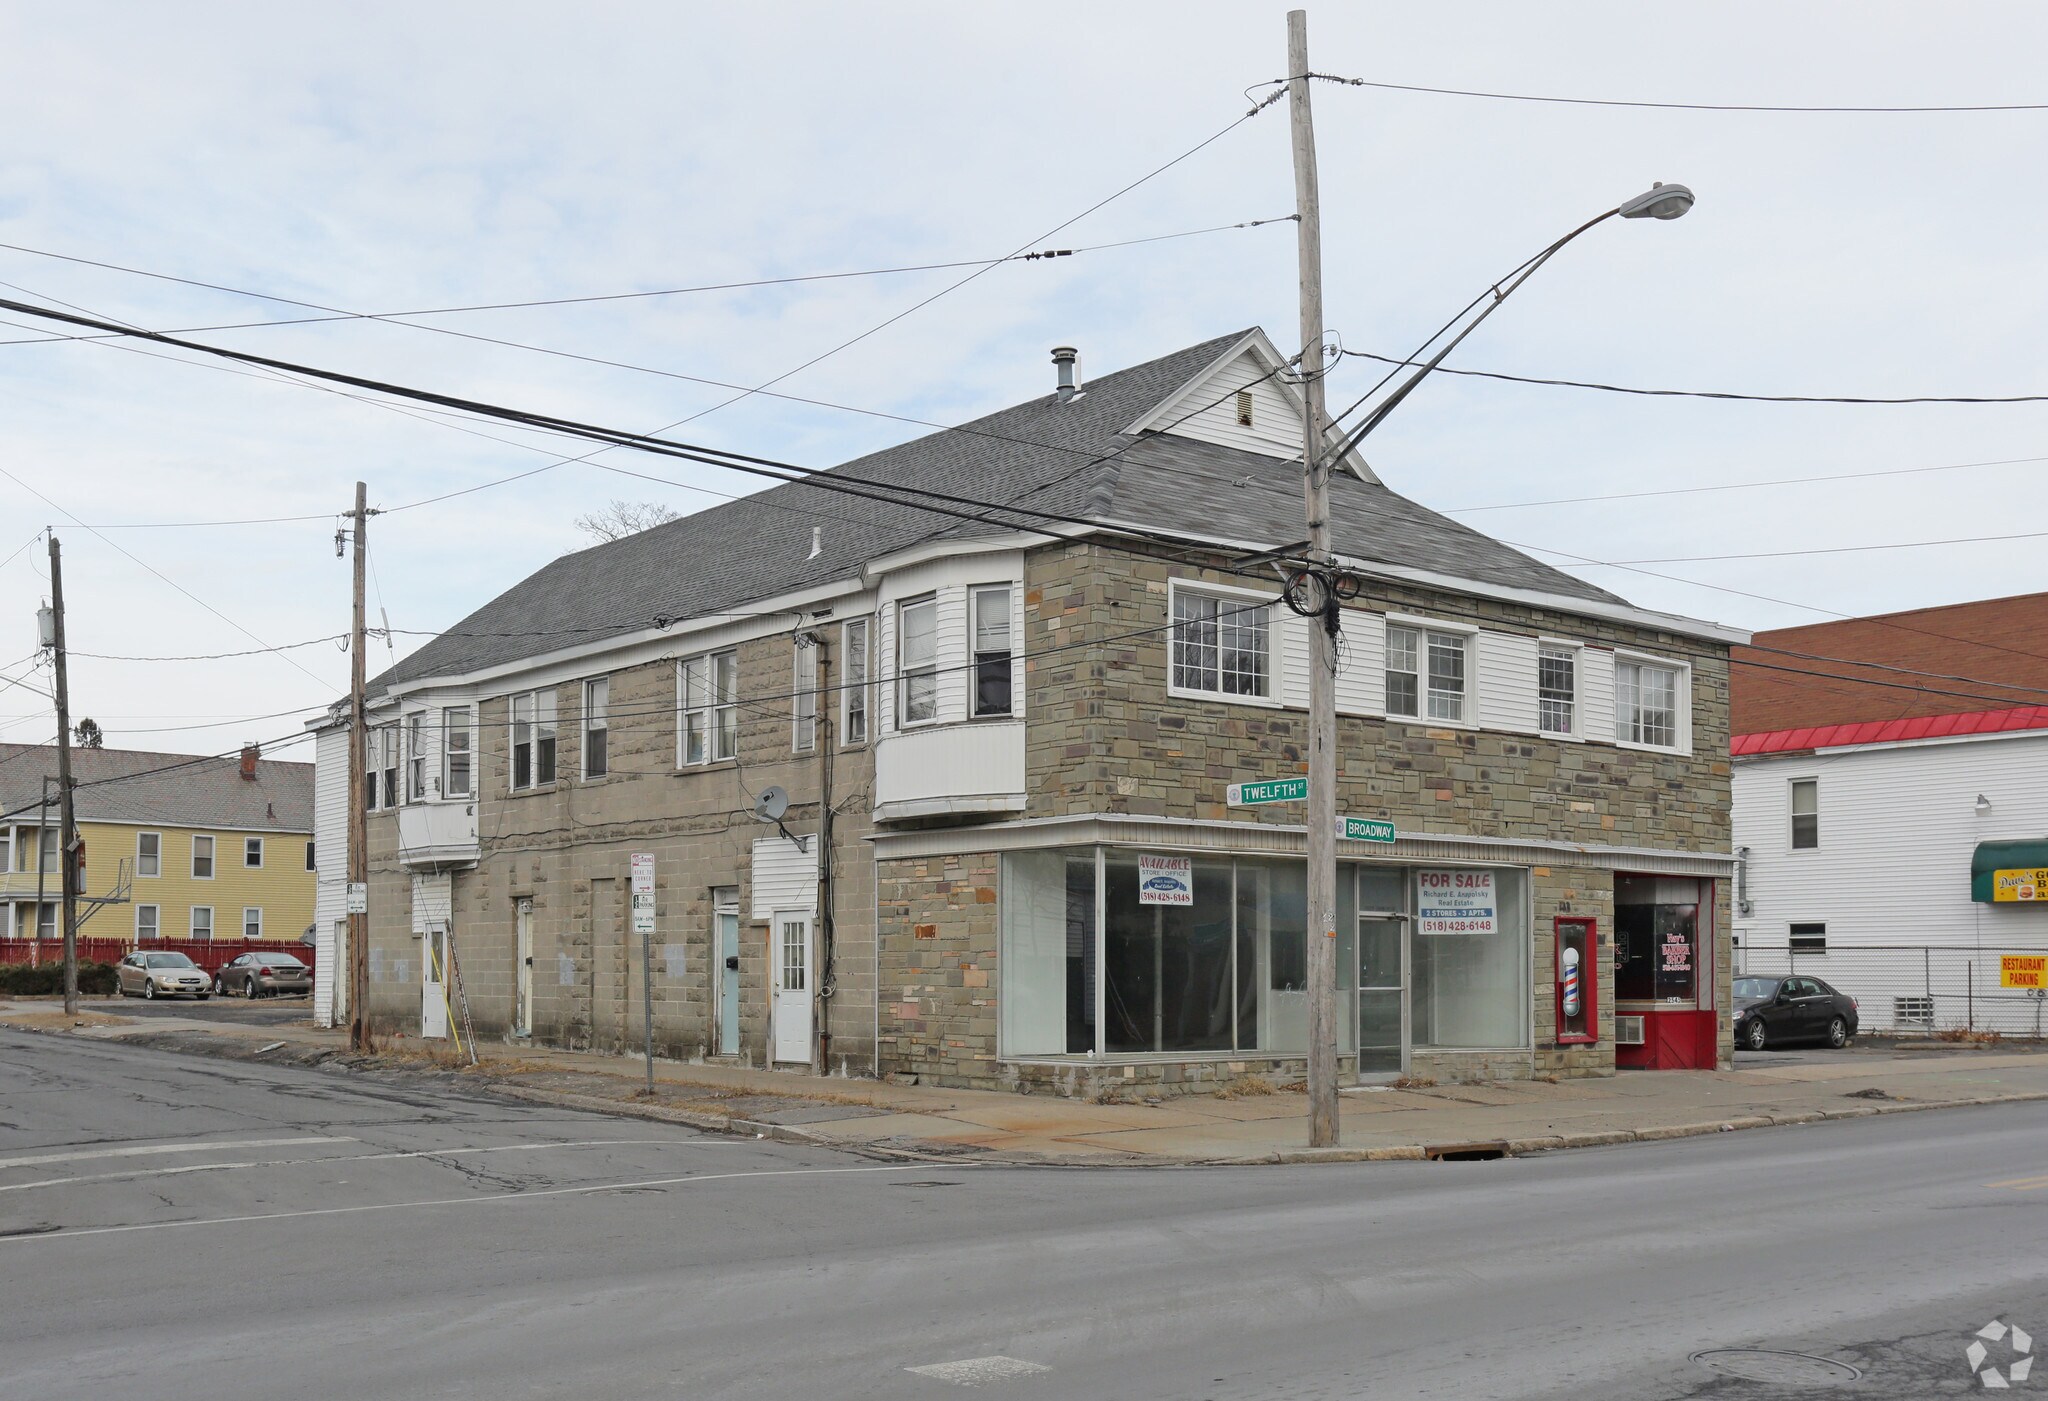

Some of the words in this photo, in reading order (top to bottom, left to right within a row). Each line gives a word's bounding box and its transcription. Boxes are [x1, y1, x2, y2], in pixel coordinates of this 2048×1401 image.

[1243, 783, 1297, 800] TWELFTH
[1298, 782, 1304, 790] ST
[1348, 822, 1392, 838] BROADWAY
[1140, 857, 1190, 870] AVAILABLE
[1421, 873, 1450, 888] FOR
[1455, 873, 1490, 888] SALE
[1999, 871, 2034, 889] Dave's
[1141, 891, 1156, 902] (518)
[1423, 890, 1448, 898] Richard
[1468, 909, 1487, 917] APTS.
[1423, 920, 1447, 932] (518)
[2002, 957, 2046, 971] RESTAURANT
[2010, 972, 2039, 986] PARKING
